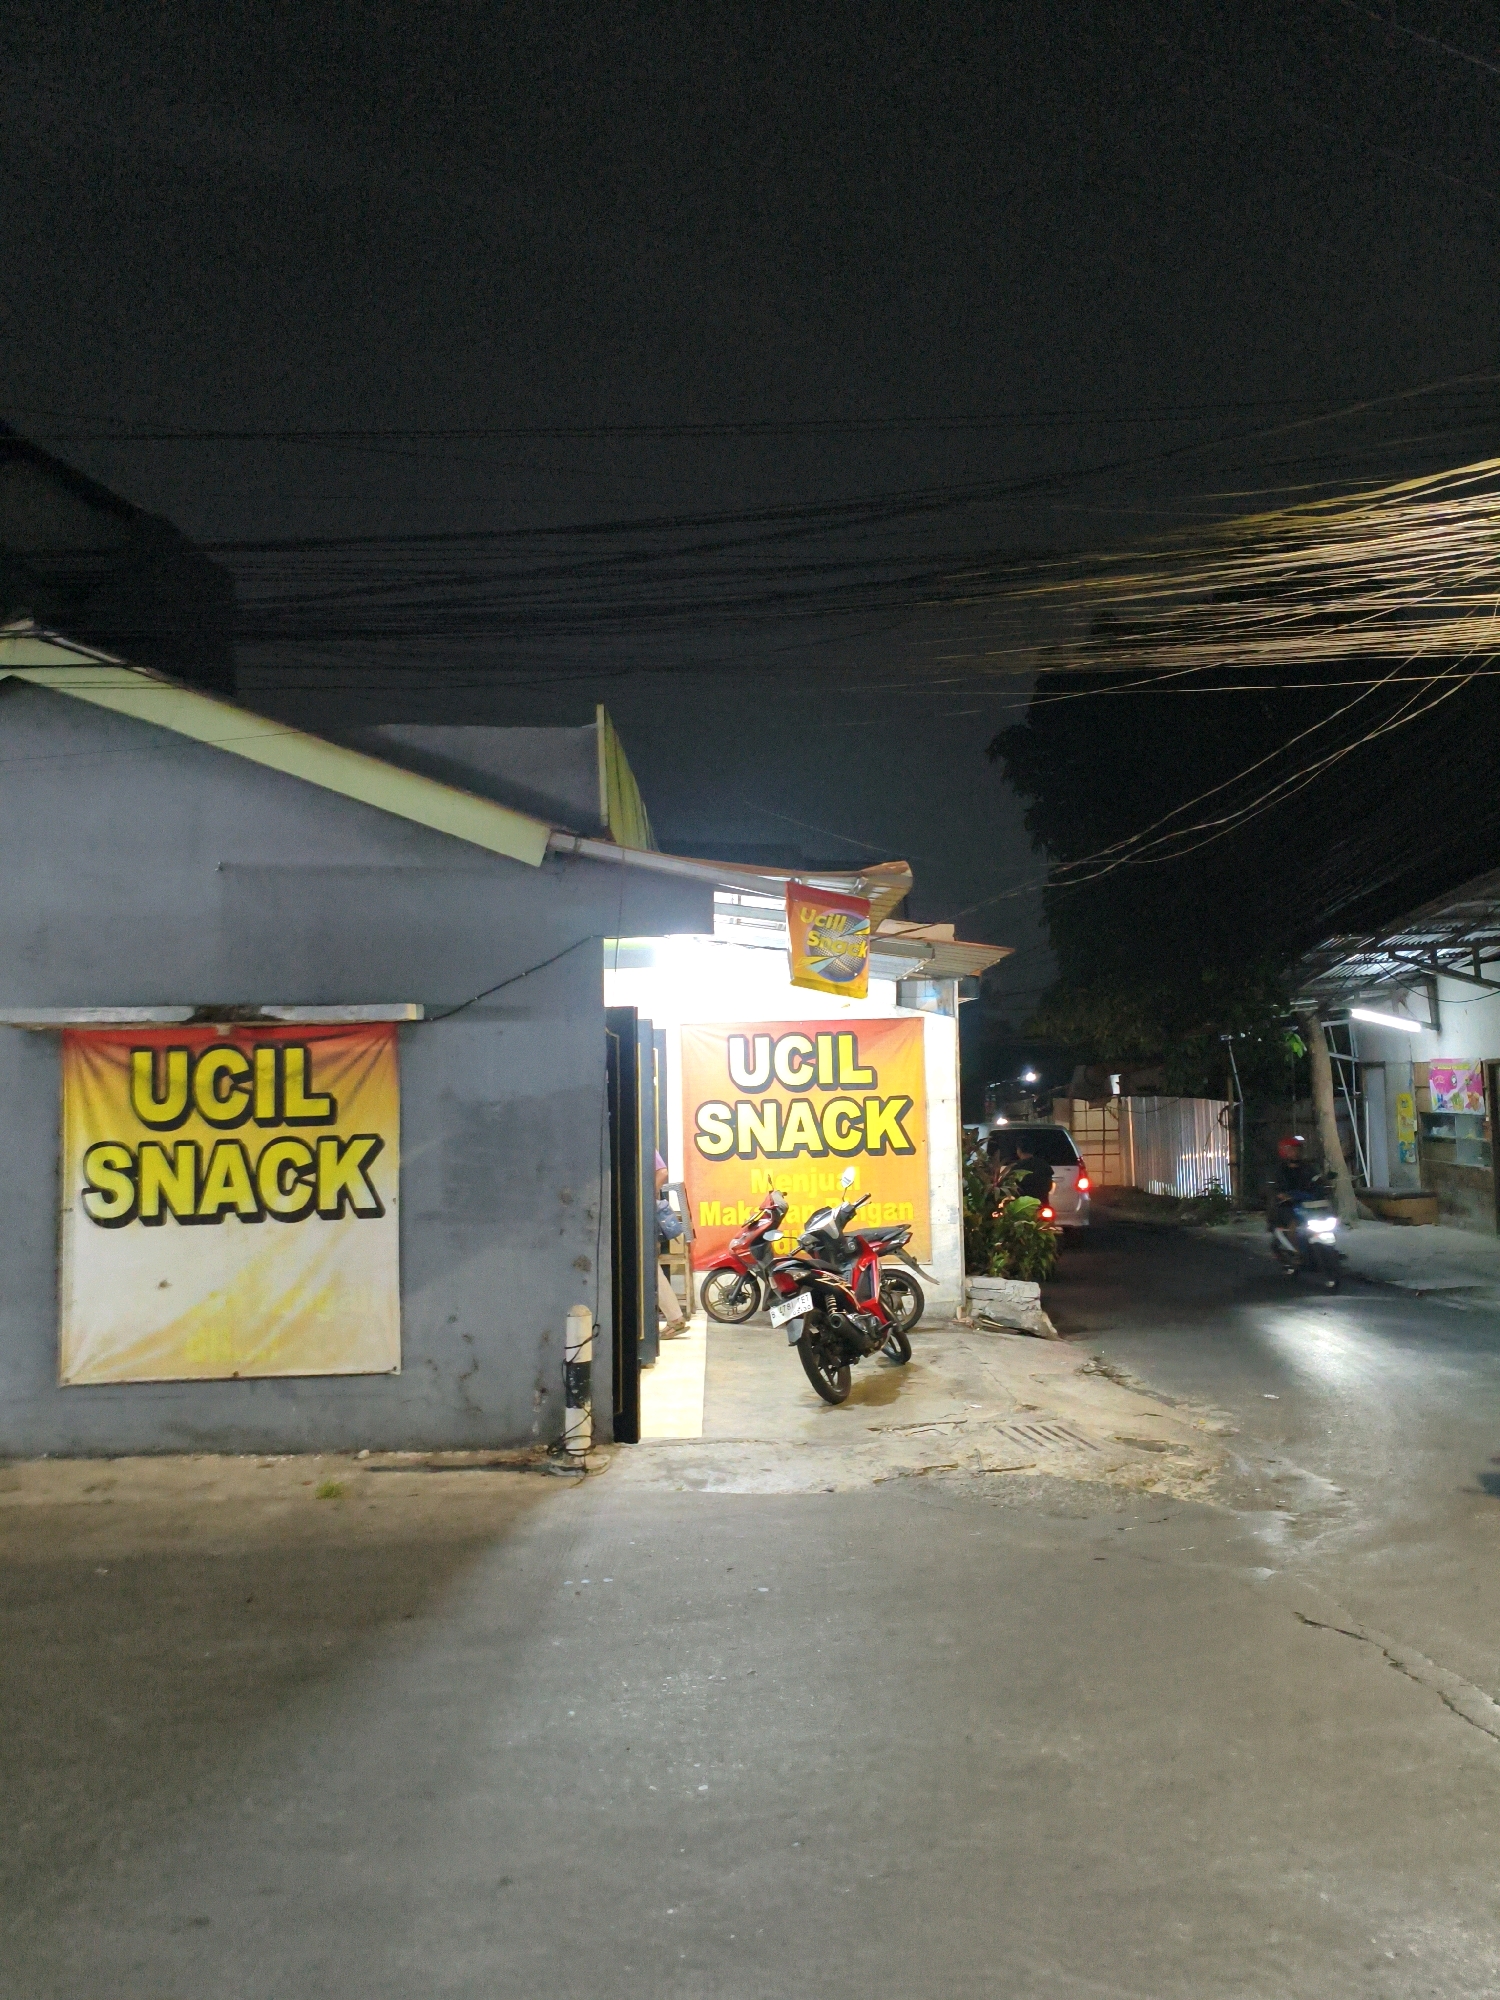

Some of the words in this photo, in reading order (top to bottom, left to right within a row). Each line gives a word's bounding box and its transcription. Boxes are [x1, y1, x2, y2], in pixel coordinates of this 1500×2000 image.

[806, 930, 868, 958] Snack
[129, 1044, 337, 1131] UCIL
[727, 1031, 877, 1094] UCIL
[695, 1095, 916, 1161] SNACK
[81, 1133, 386, 1229] SNACK
[699, 1201, 816, 1226] Makan
